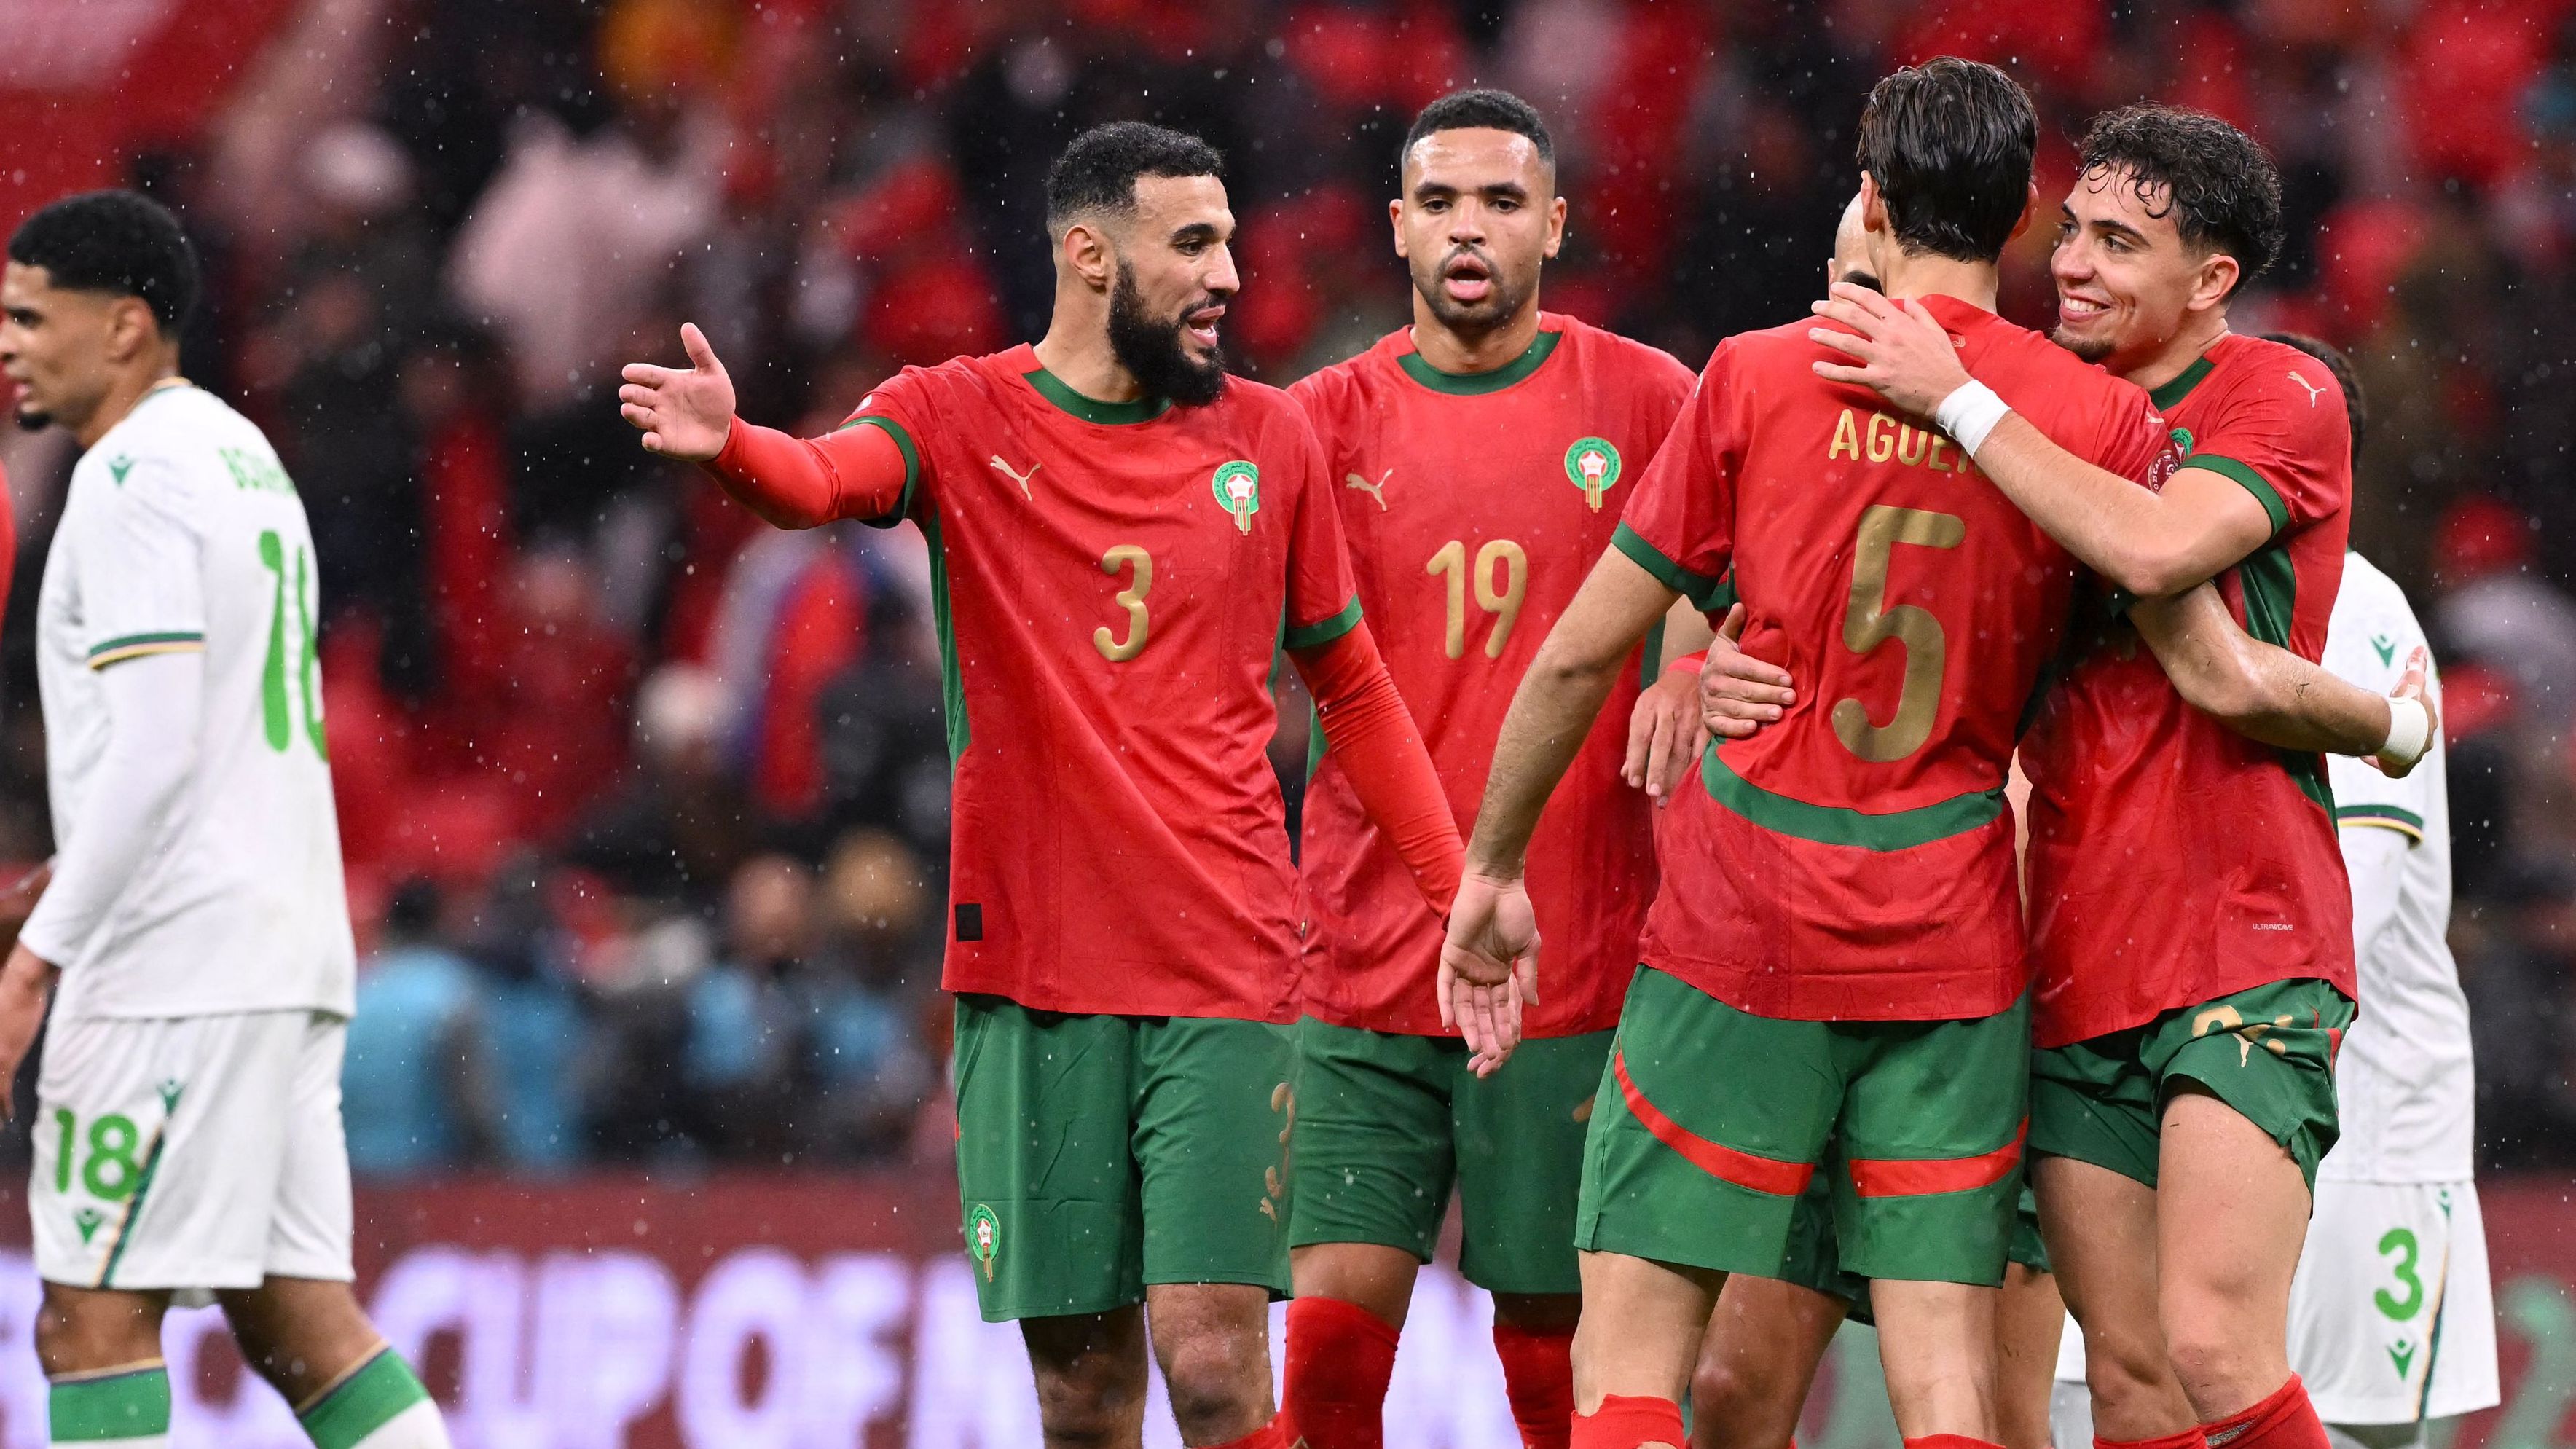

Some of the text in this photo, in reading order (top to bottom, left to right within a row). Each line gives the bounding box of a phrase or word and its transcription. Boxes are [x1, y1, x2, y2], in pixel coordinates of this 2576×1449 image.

[1093, 544, 1152, 661] 3
[1426, 539, 1528, 659] 19
[1831, 505, 1966, 763] 5
[2253, 923, 2293, 931] ULTRAWEAVE
[55, 1107, 140, 1201] 18
[2374, 1228, 2424, 1322] 3
[678, 1244, 911, 1449] OF
